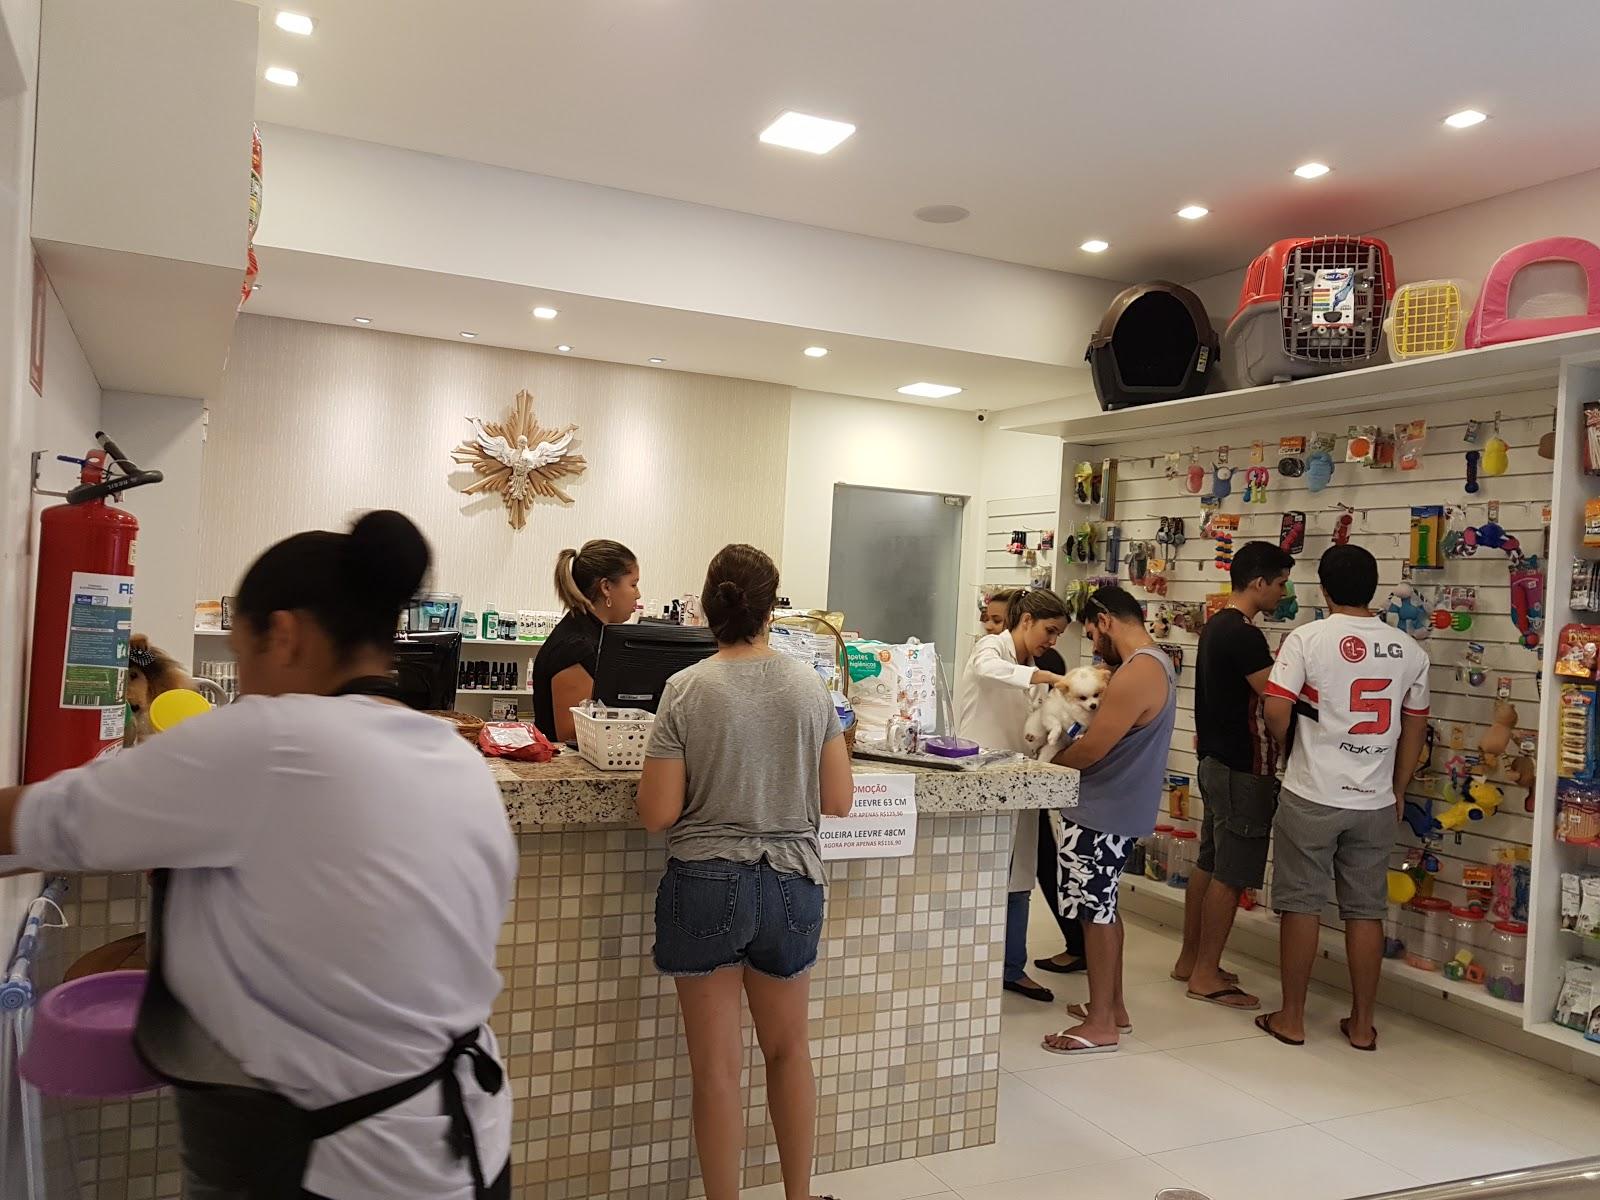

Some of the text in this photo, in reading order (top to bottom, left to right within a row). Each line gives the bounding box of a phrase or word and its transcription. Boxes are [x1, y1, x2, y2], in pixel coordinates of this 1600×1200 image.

[1374, 642, 1404, 658] LG
[847, 654, 869, 662] apetes
[1348, 678, 1393, 735] 5
[853, 784, 887, 795] OMOÇÃO
[854, 797, 907, 808] LEEVRE 63 CM
[819, 828, 906, 840] COLEIRA LEEVRE 48CM
[823, 841, 843, 849] AGORA
